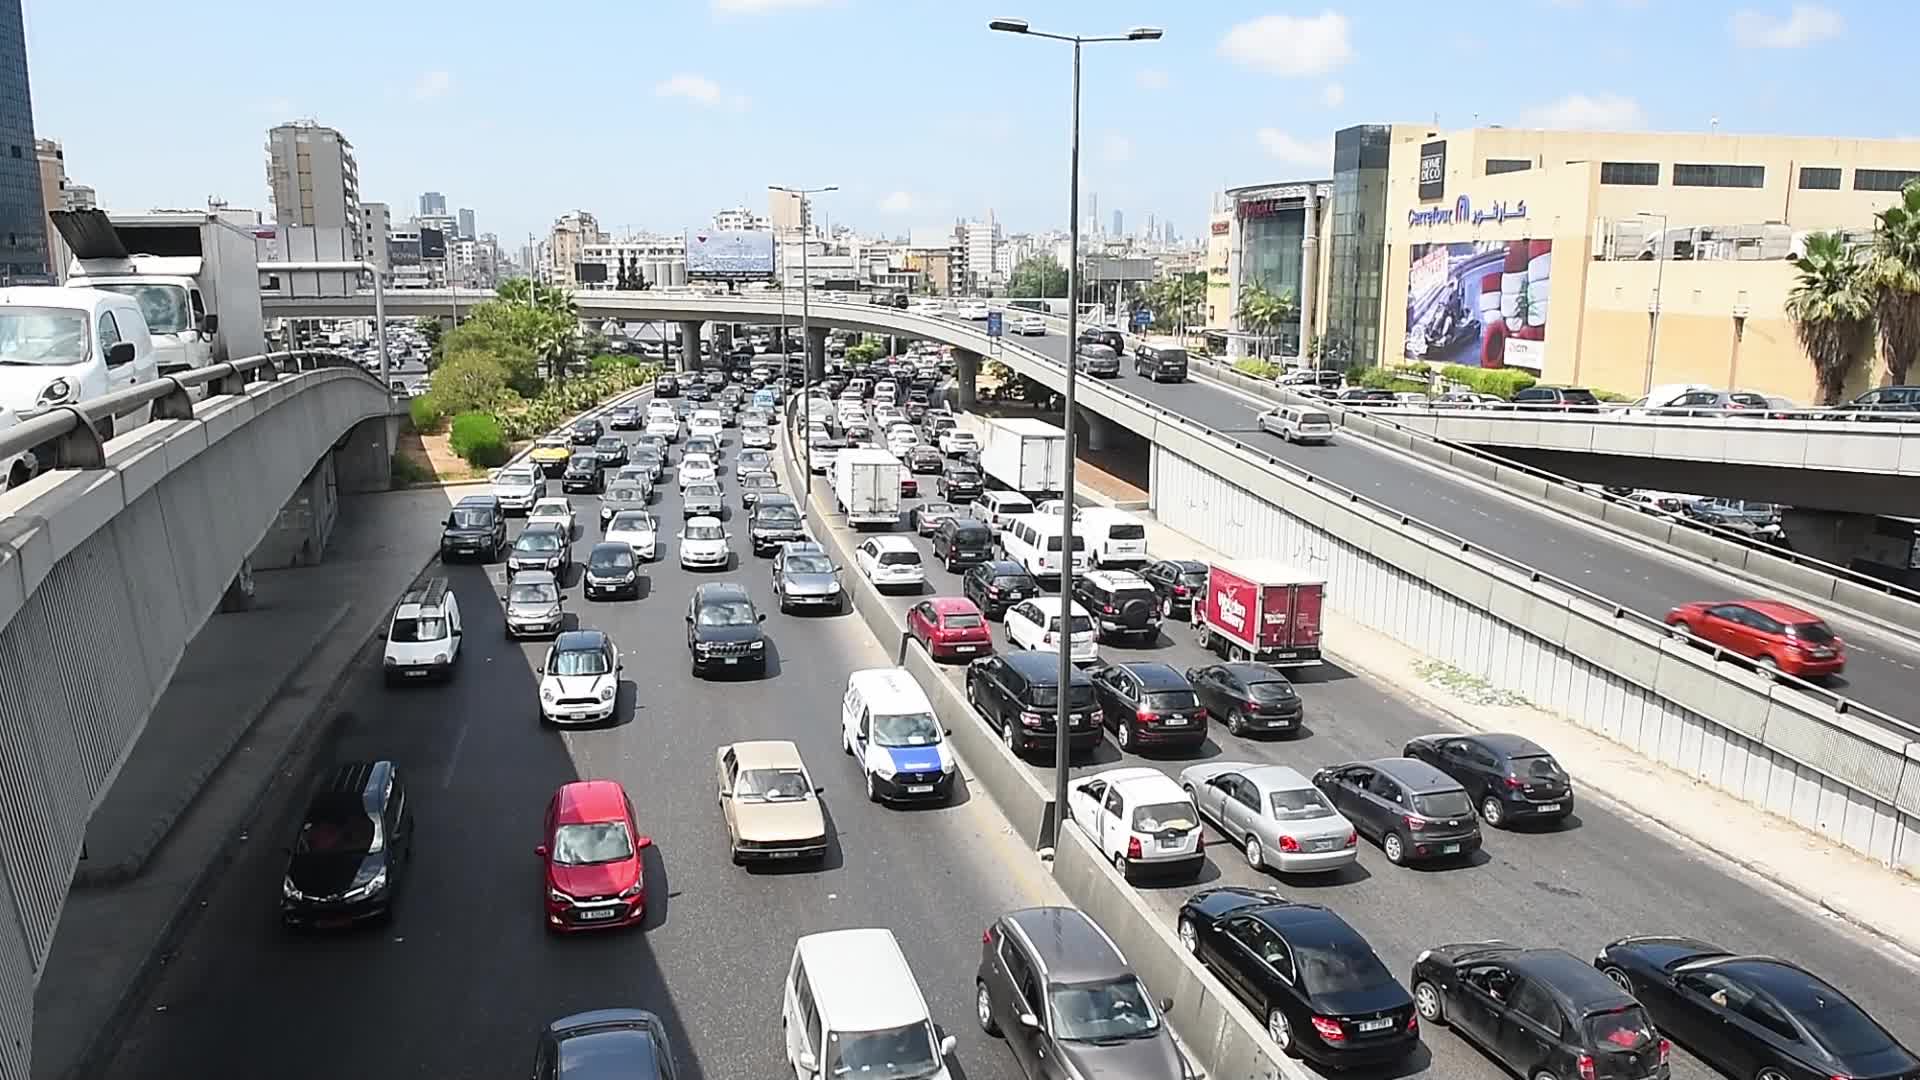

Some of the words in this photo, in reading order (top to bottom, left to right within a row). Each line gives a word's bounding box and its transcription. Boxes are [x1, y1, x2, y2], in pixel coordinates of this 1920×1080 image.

[1421, 168, 1441, 181] DECO
[1408, 207, 1453, 228] Carrefour
[1472, 199, 1527, 227] كارفور
